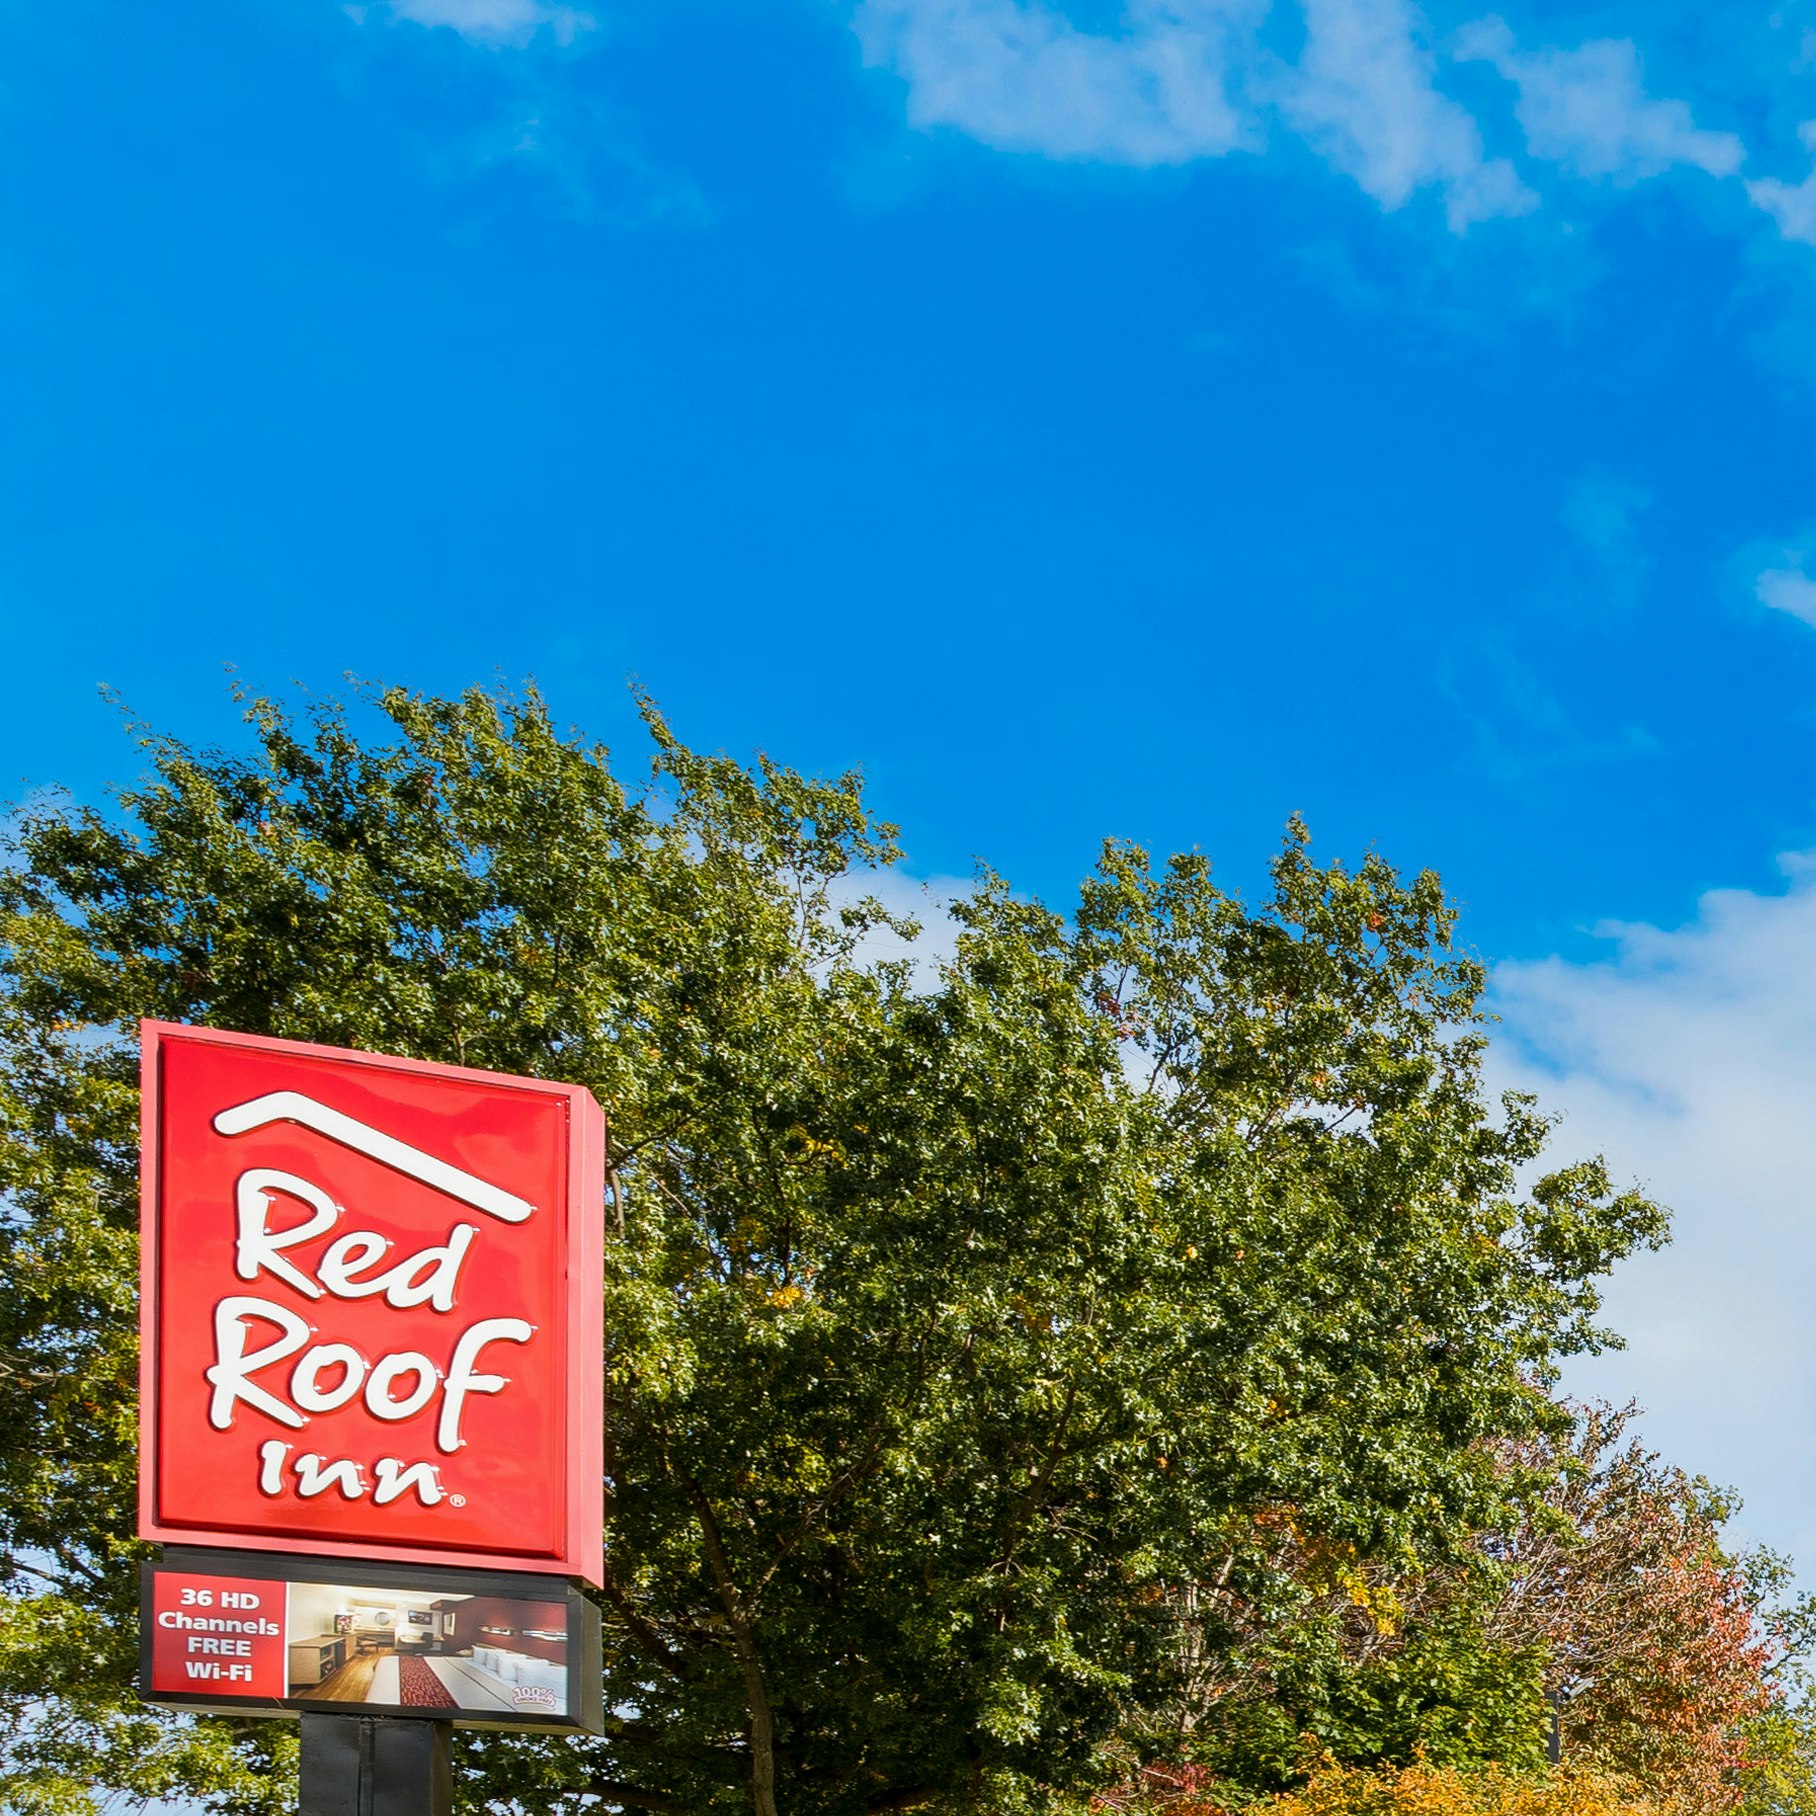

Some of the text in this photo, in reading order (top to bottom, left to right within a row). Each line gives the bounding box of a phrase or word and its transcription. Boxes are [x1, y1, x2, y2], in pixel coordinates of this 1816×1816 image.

[235, 1168, 474, 1313] Red
[206, 1296, 533, 1453] Roof
[180, 1588, 260, 1610] 36 HD
[158, 1611, 280, 1636] Channels
[187, 1636, 252, 1657] FREE
[185, 1661, 252, 1682] Wi-Fi
